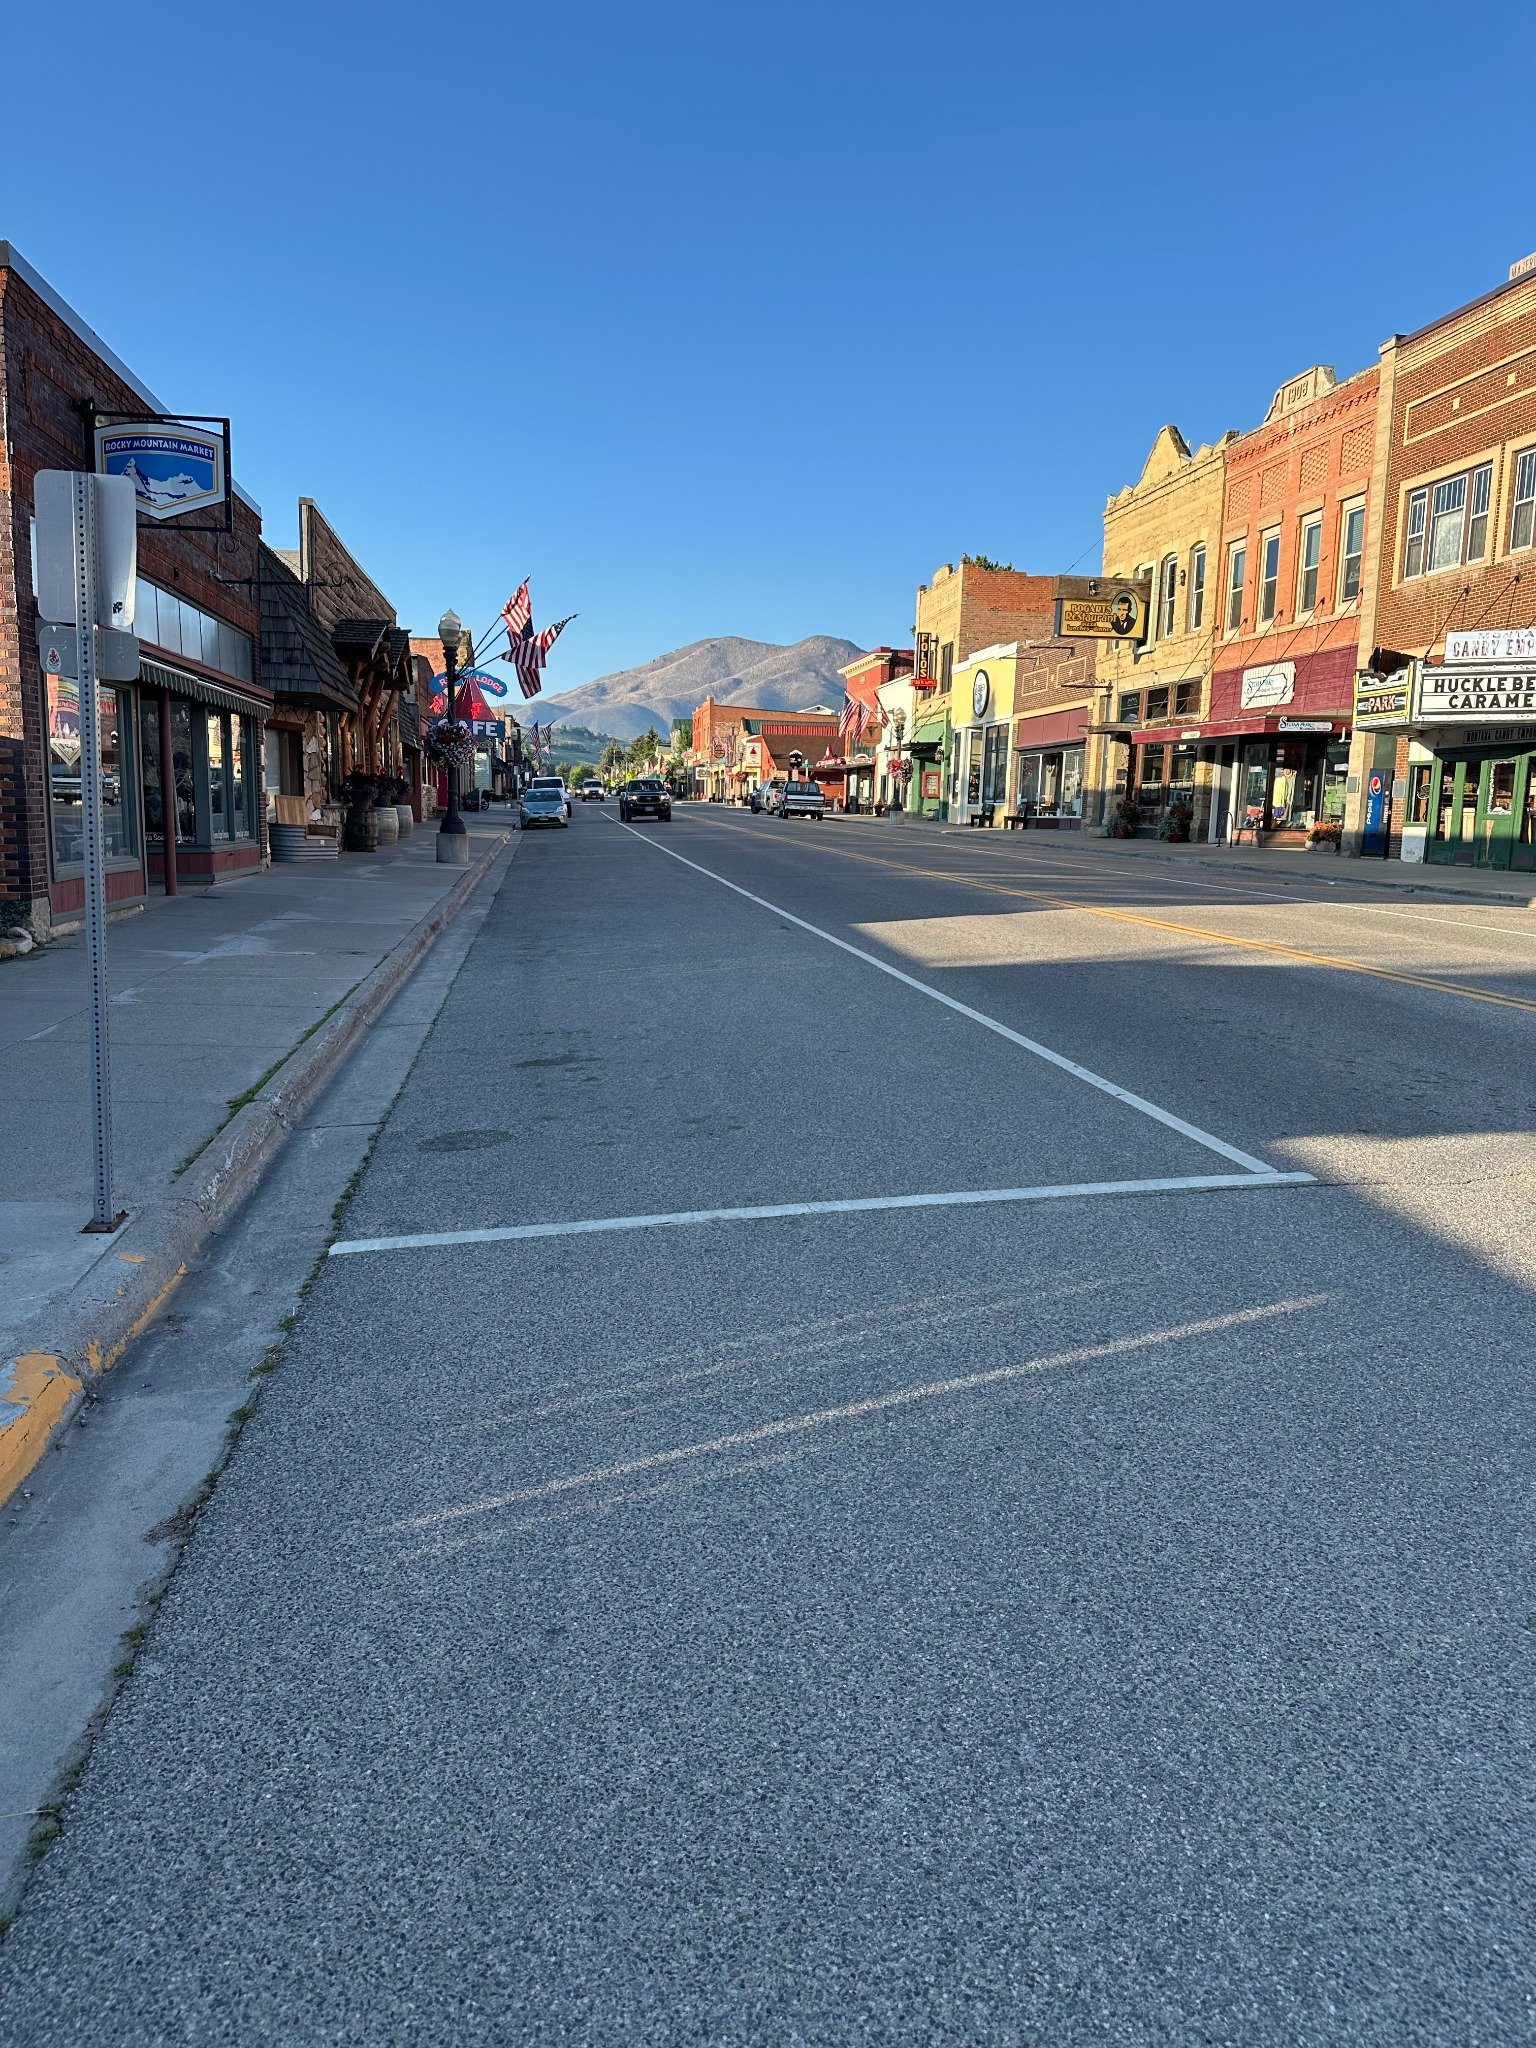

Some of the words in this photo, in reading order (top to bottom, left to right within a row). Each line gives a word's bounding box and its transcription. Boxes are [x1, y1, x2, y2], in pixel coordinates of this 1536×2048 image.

[1288, 381, 1309, 405] 1908
[105, 440, 131, 452] ROCKY
[133, 439, 178, 450] MOUNTAIN
[180, 444, 214, 458] MARKET
[1065, 611, 1117, 622] Restaurant
[1071, 603, 1112, 613] BOGARTS
[919, 633, 929, 678] FOLOS
[1453, 640, 1500, 657] CANDY
[1506, 638, 1535, 656] EMP
[475, 675, 504, 693] LODGE
[1368, 695, 1396, 712] PARK
[1448, 693, 1534, 709] CARAME
